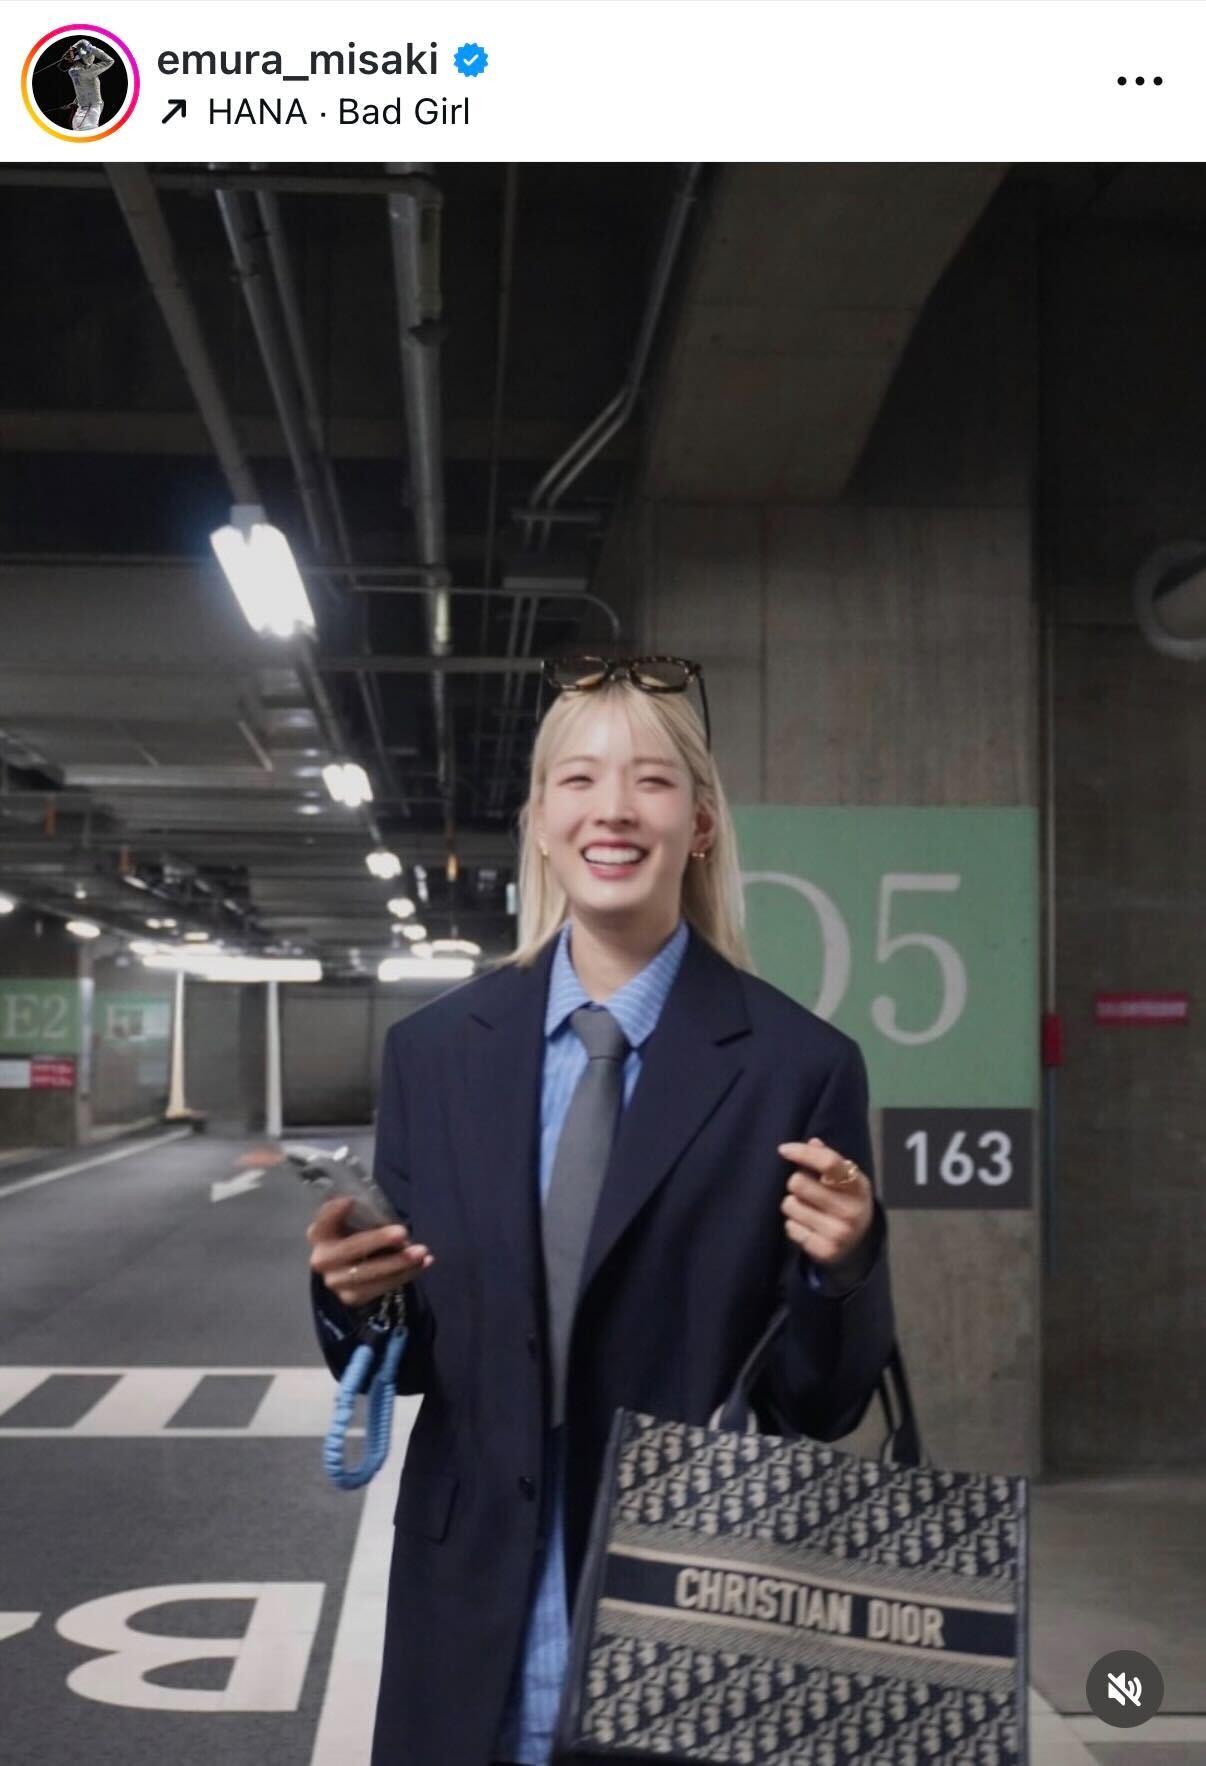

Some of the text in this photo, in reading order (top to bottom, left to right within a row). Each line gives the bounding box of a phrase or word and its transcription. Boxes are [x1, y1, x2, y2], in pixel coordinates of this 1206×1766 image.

[4, 994, 67, 1040] E2
[905, 1131, 1013, 1187] 163
[675, 1567, 946, 1648] CHRISTIAN DIOR
[0, 1582, 326, 1713] B
